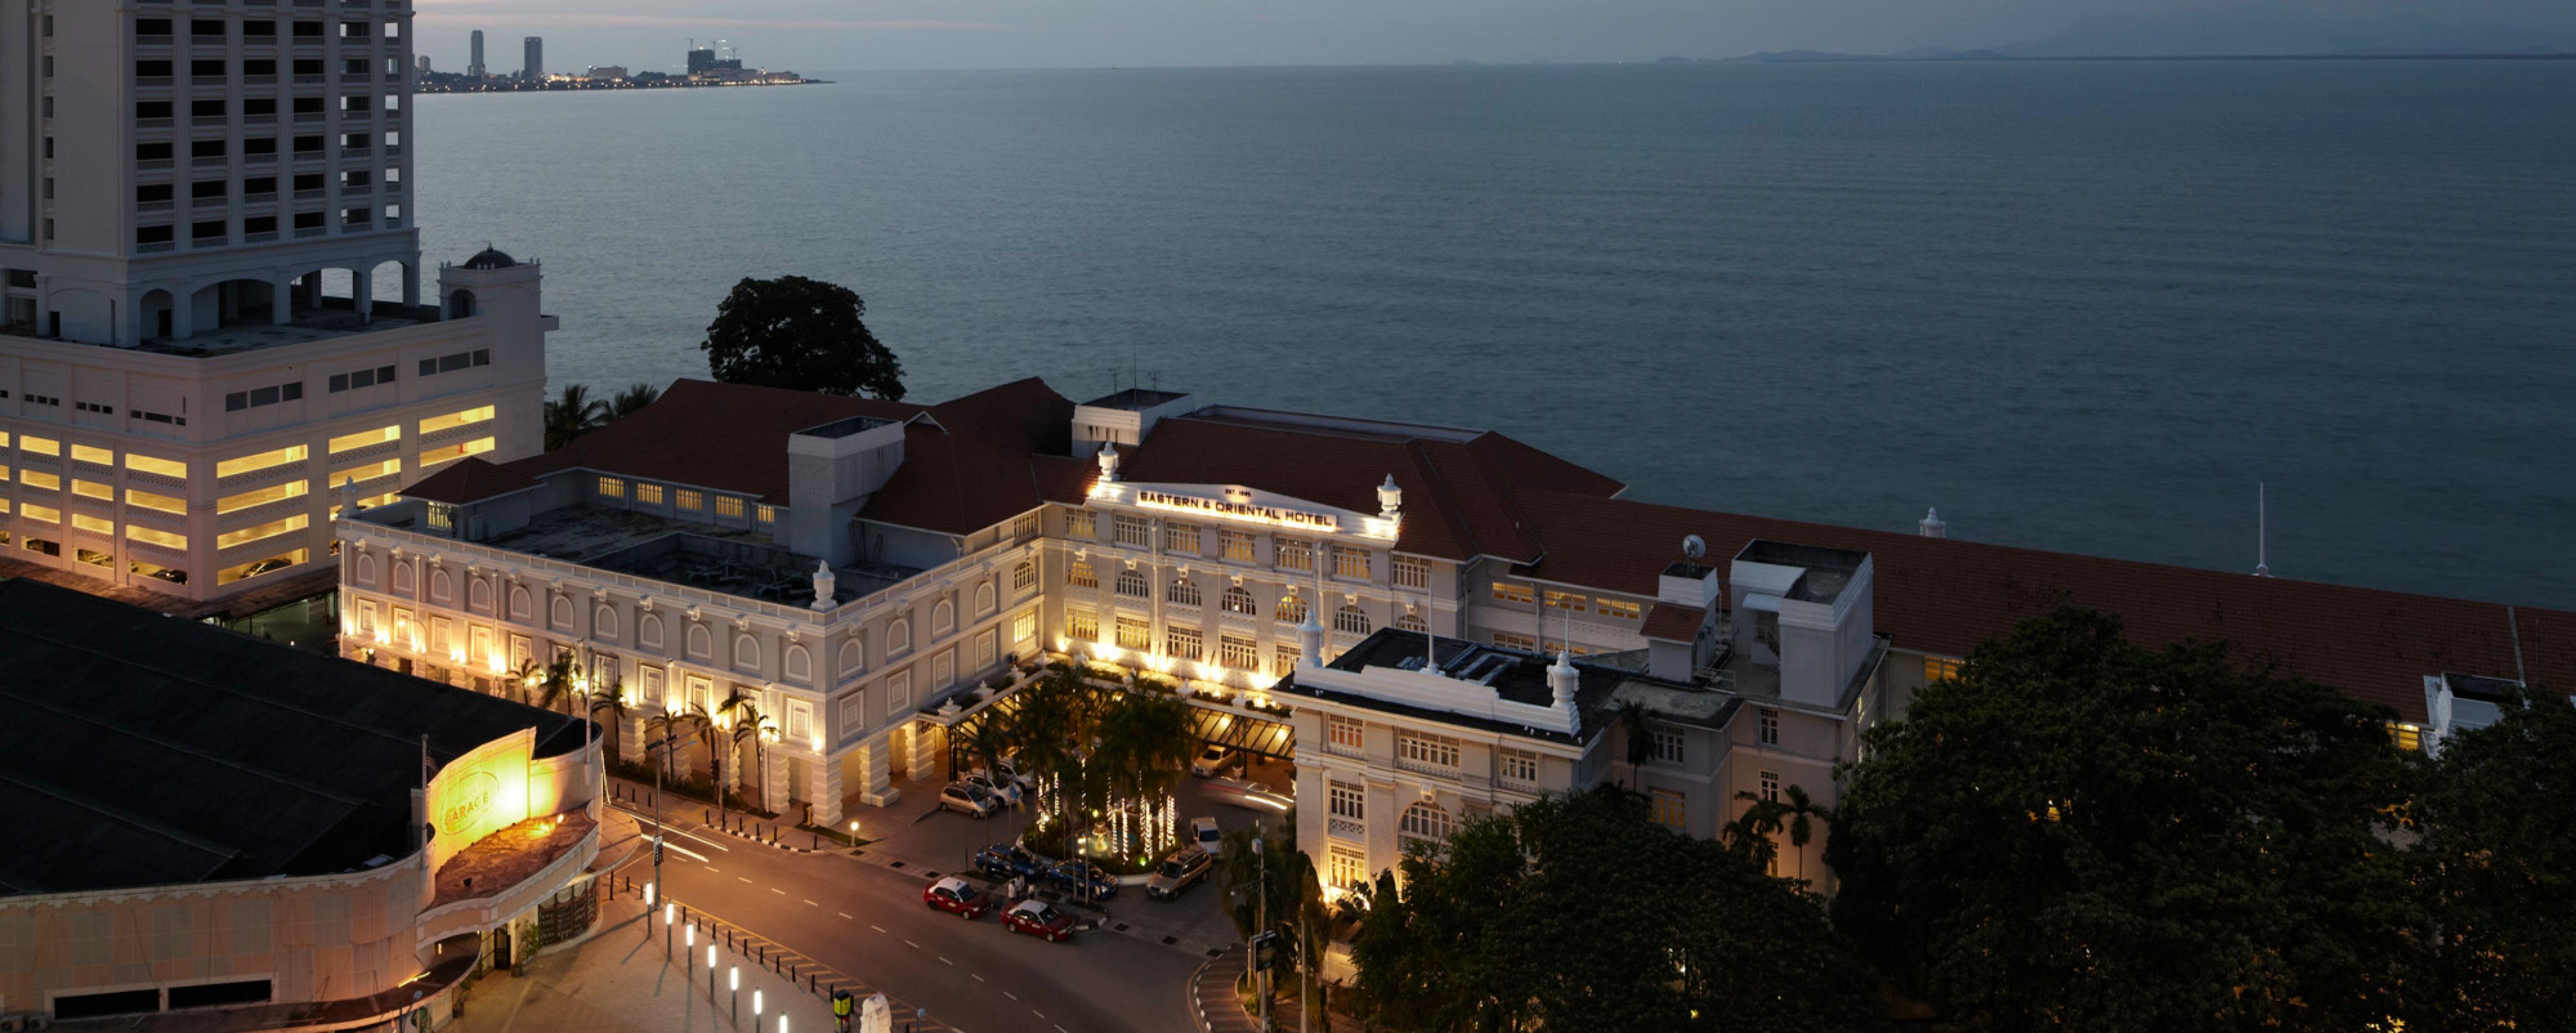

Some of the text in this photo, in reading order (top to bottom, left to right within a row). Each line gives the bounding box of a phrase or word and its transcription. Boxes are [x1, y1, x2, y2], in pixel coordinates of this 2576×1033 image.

[1140, 492, 1332, 526] EASTERN & ORIENTAL HOTEL
[445, 791, 489, 826] GARAGE
